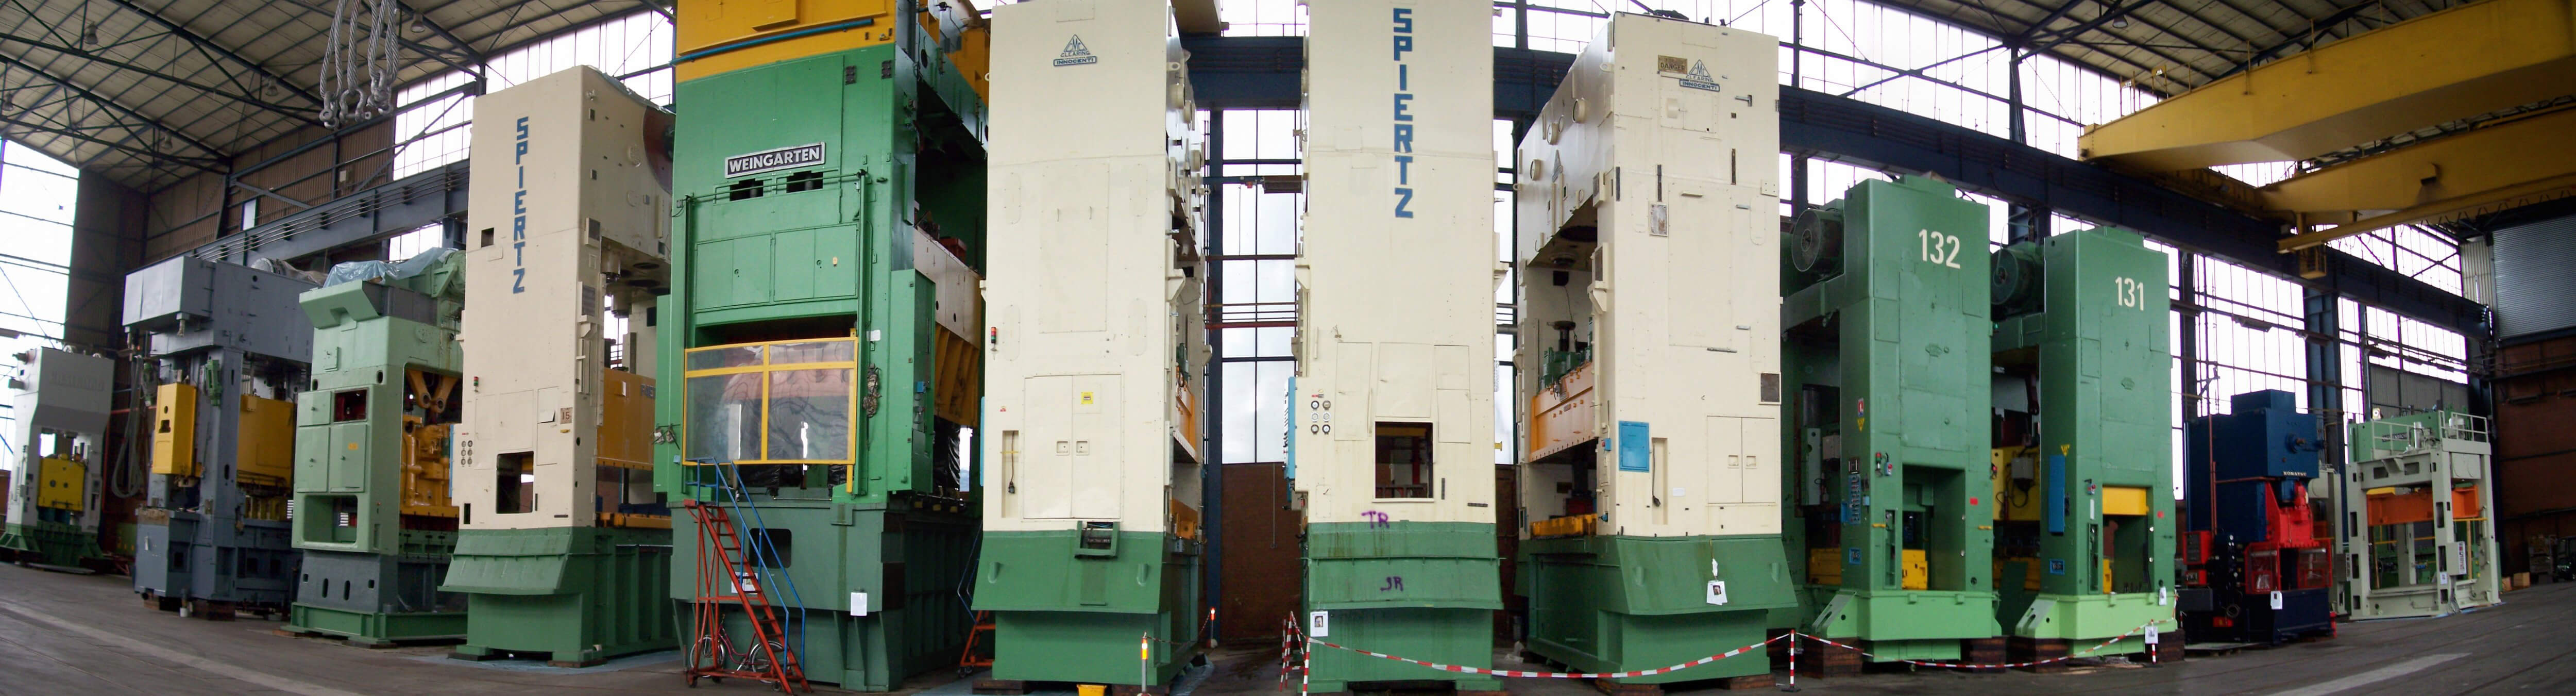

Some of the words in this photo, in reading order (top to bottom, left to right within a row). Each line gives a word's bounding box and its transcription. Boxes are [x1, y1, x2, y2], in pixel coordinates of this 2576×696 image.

[1660, 62, 1685, 71] DANGER
[1685, 74, 1714, 82] CLEARING
[1682, 81, 1717, 90] INNOCENTI
[1393, 8, 1414, 219] SPIERTZ
[729, 146, 820, 173] WEINGARTEN
[513, 116, 529, 294] SPIERTZ
[1919, 228, 1960, 269] 132
[2115, 276, 2144, 311] 131
[1361, 511, 1390, 529] TR
